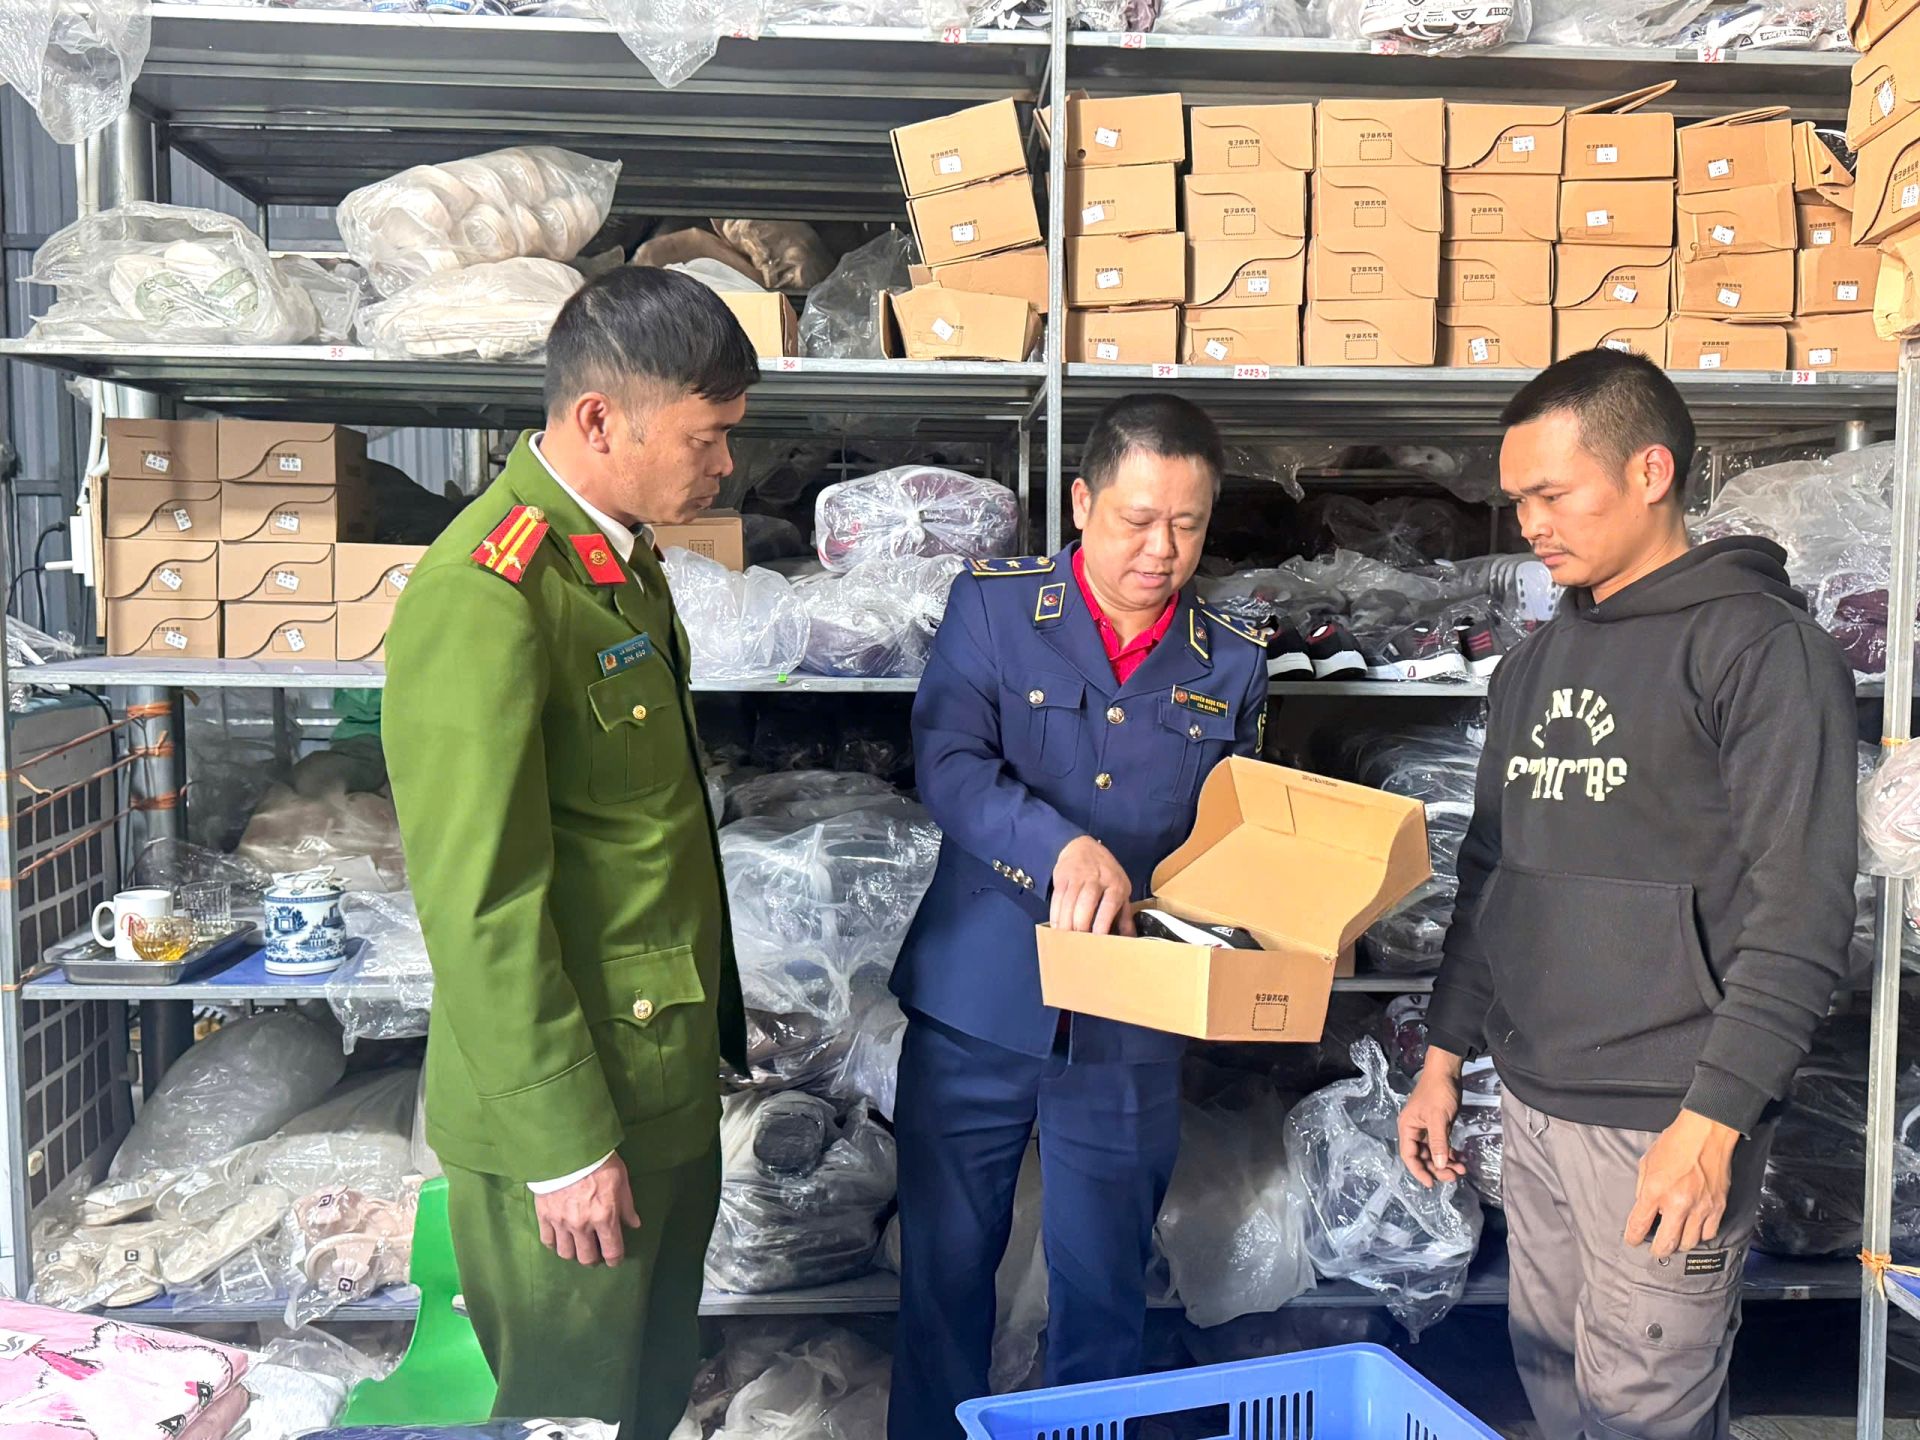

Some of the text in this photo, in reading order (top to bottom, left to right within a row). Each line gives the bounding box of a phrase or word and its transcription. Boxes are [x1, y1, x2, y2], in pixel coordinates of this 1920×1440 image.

[943, 27, 961, 44] 28
[1123, 34, 1143, 48] 29
[1703, 48, 1721, 62] 31
[330, 347, 344, 358] 35
[783, 359, 796, 370] 36
